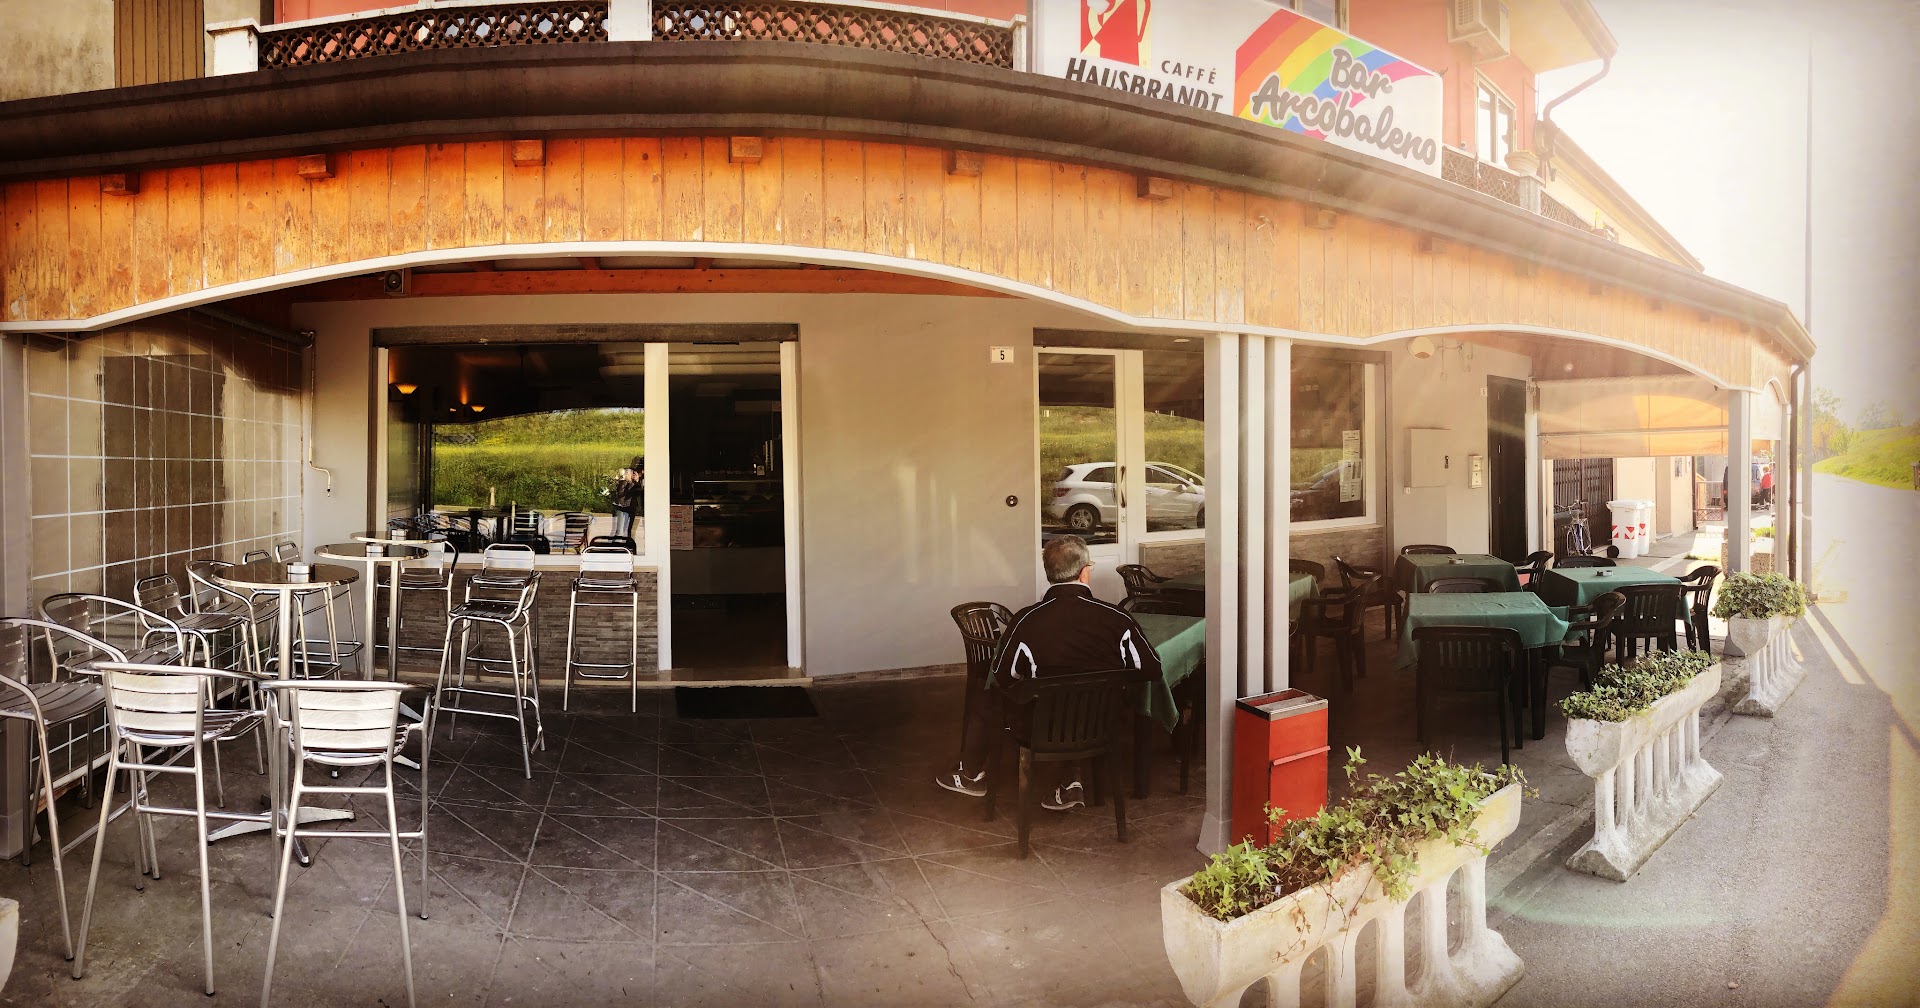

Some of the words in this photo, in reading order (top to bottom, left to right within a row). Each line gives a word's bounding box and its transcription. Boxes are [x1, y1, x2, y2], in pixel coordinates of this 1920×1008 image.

[1065, 57, 1224, 112] HAUSBRANDT
[1161, 60, 1217, 85] CAFFÉ
[1331, 48, 1393, 99] Bar
[1251, 74, 1437, 166] Arcobaleno
